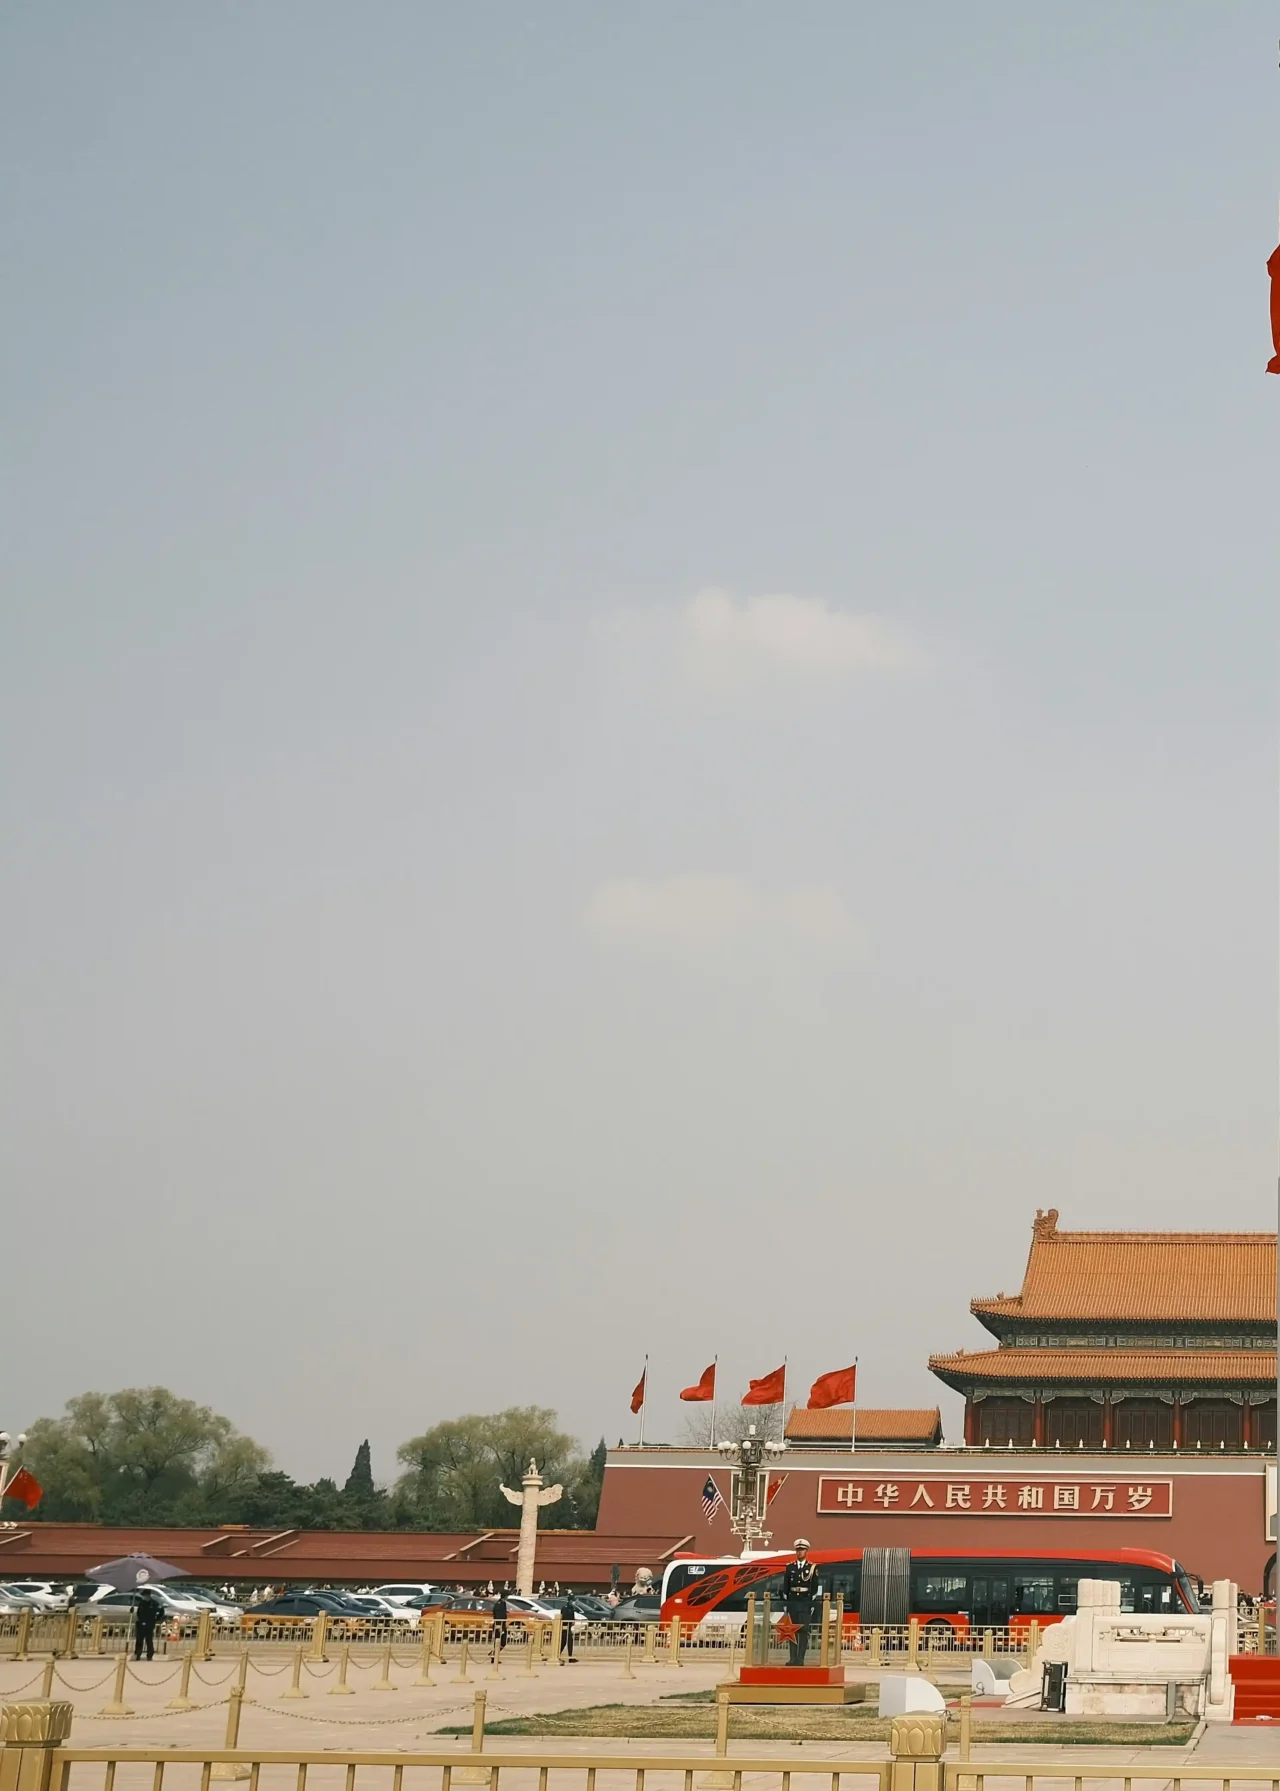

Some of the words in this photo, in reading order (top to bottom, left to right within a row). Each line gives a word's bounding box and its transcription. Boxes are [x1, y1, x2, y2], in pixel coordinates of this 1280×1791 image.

[836, 1483, 1154, 1511] 中华人民共和国万岁
